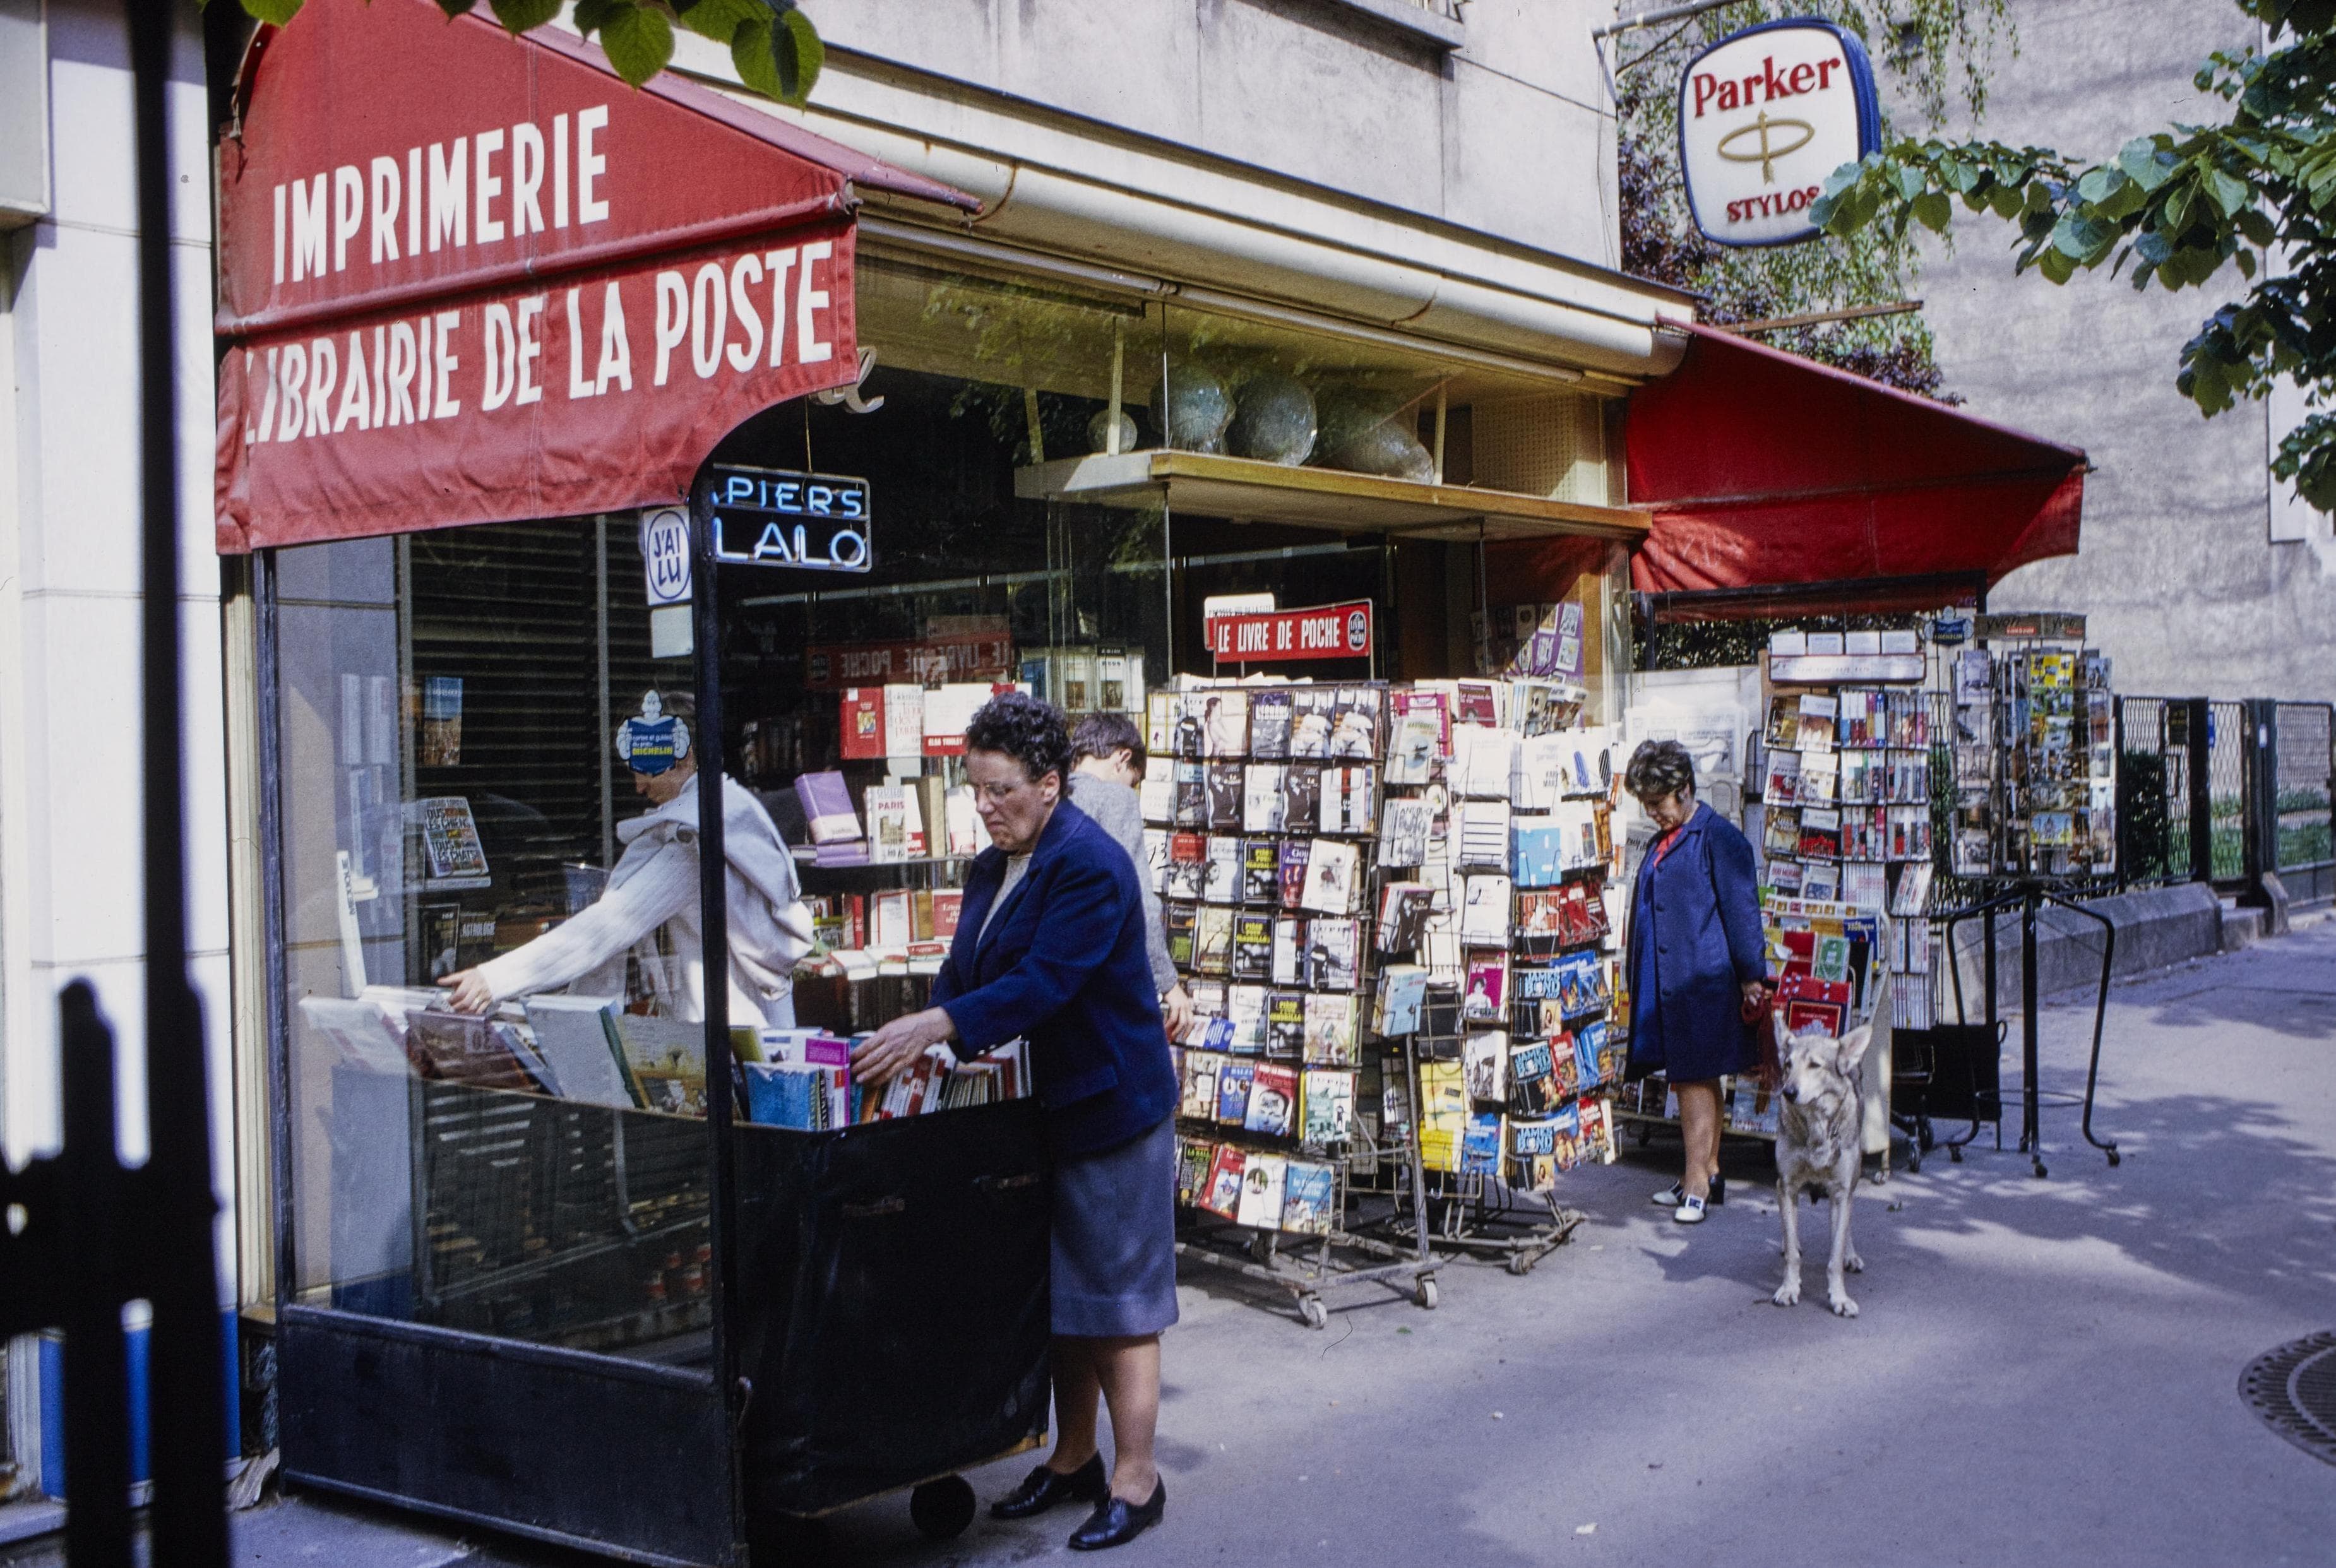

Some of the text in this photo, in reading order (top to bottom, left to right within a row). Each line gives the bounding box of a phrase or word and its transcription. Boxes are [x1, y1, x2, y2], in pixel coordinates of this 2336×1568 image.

[1693, 56, 1840, 118] Parker
[273, 104, 609, 285] IMPRIMERIE
[1726, 186, 1820, 223] STYLOS
[482, 293, 544, 412] DE
[566, 280, 633, 399] LA
[652, 241, 833, 386] POSTE
[711, 475, 863, 517] PIERS
[653, 527, 681, 558] J'AI
[713, 516, 866, 567] LALO
[657, 555, 681, 587] LU
[1218, 616, 1340, 653] LE LIVRE DE POCHE
[633, 747, 673, 756] MICHELIN
[878, 800, 905, 811] PARIS
[1525, 977, 1560, 997] BOND
[1529, 971, 1560, 980] JAMES
[1515, 1044, 1549, 1062] JAMES
[1515, 1055, 1551, 1079] BOND
[1517, 1134, 1554, 1153] BOND
[1518, 1127, 1553, 1138] JAMES
